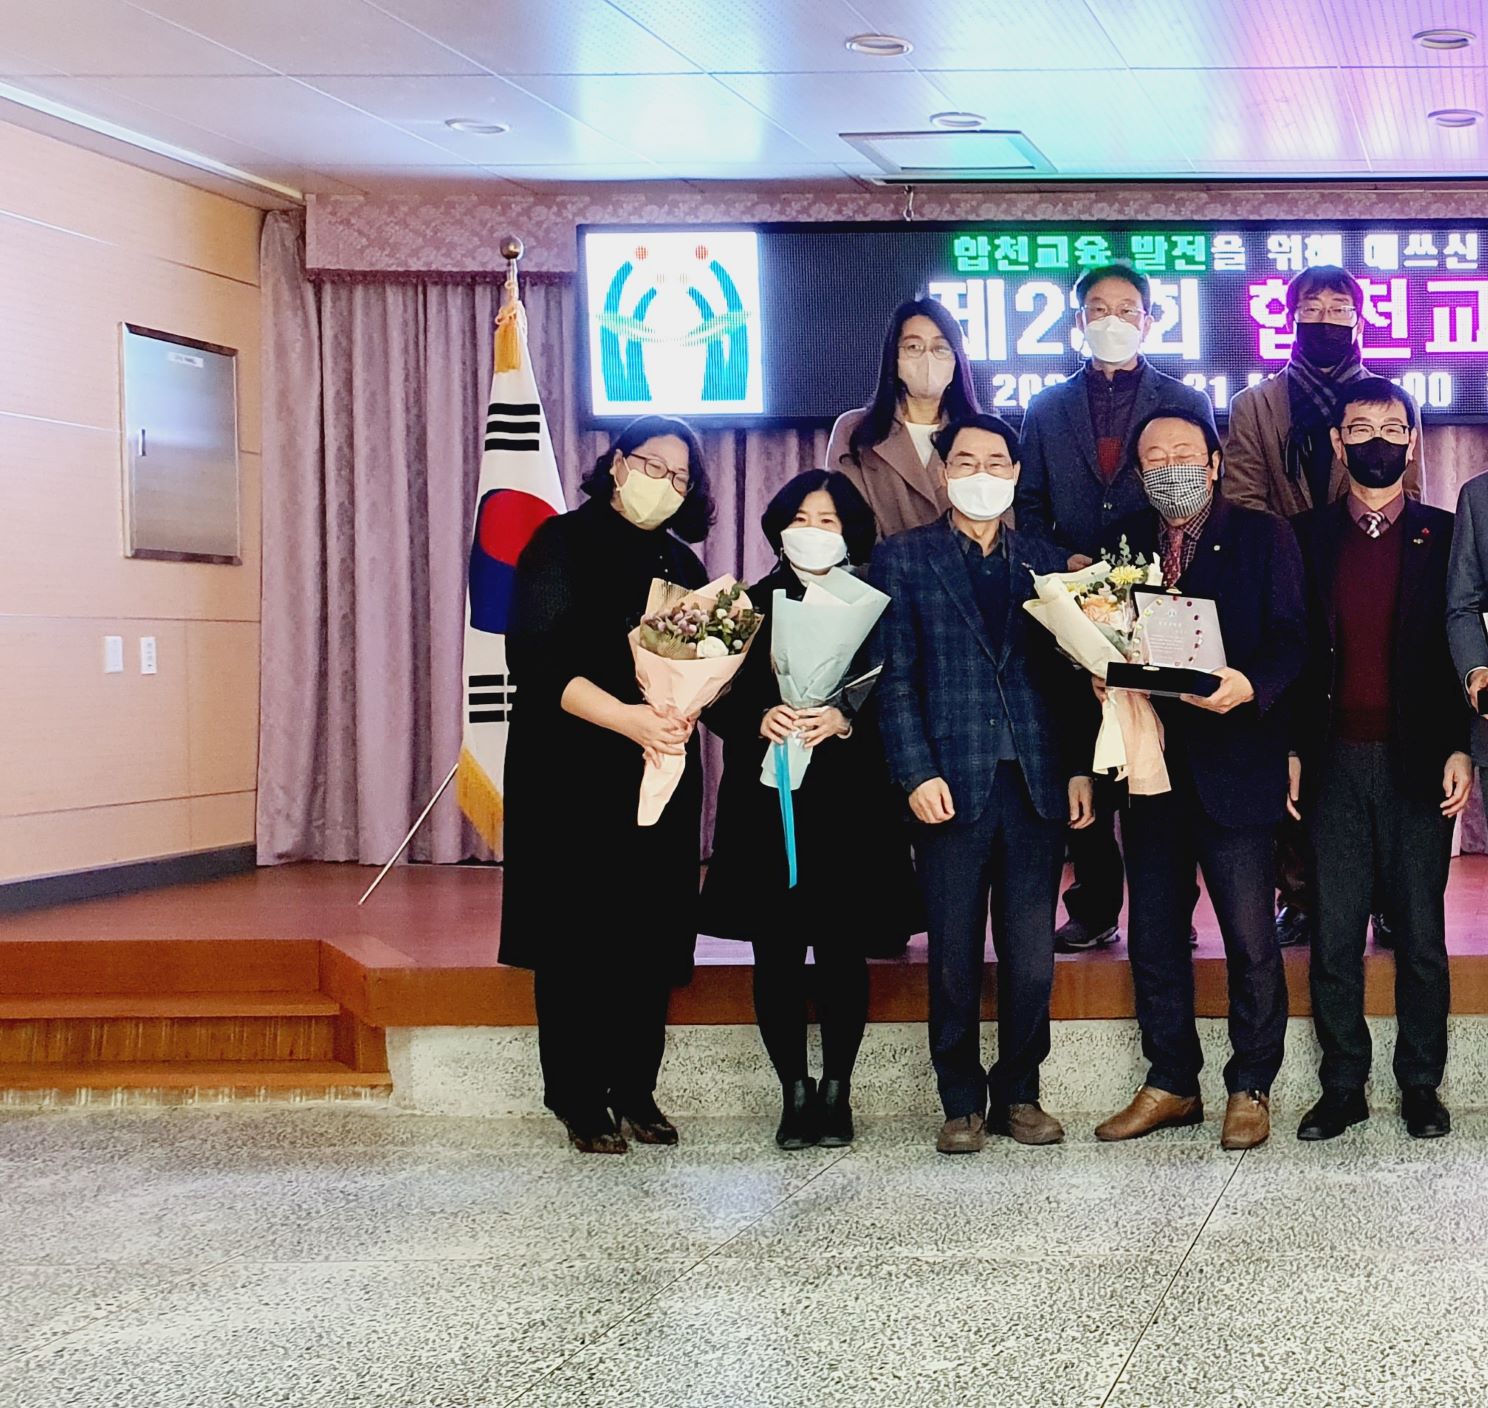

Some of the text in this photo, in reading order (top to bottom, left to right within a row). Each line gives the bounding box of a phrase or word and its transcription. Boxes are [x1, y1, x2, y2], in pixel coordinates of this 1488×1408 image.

[954, 235, 1113, 271] 합천교육
[1131, 234, 1246, 271] 발전을
[1266, 234, 1343, 271] 위해
[929, 278, 1200, 360] 제2회
